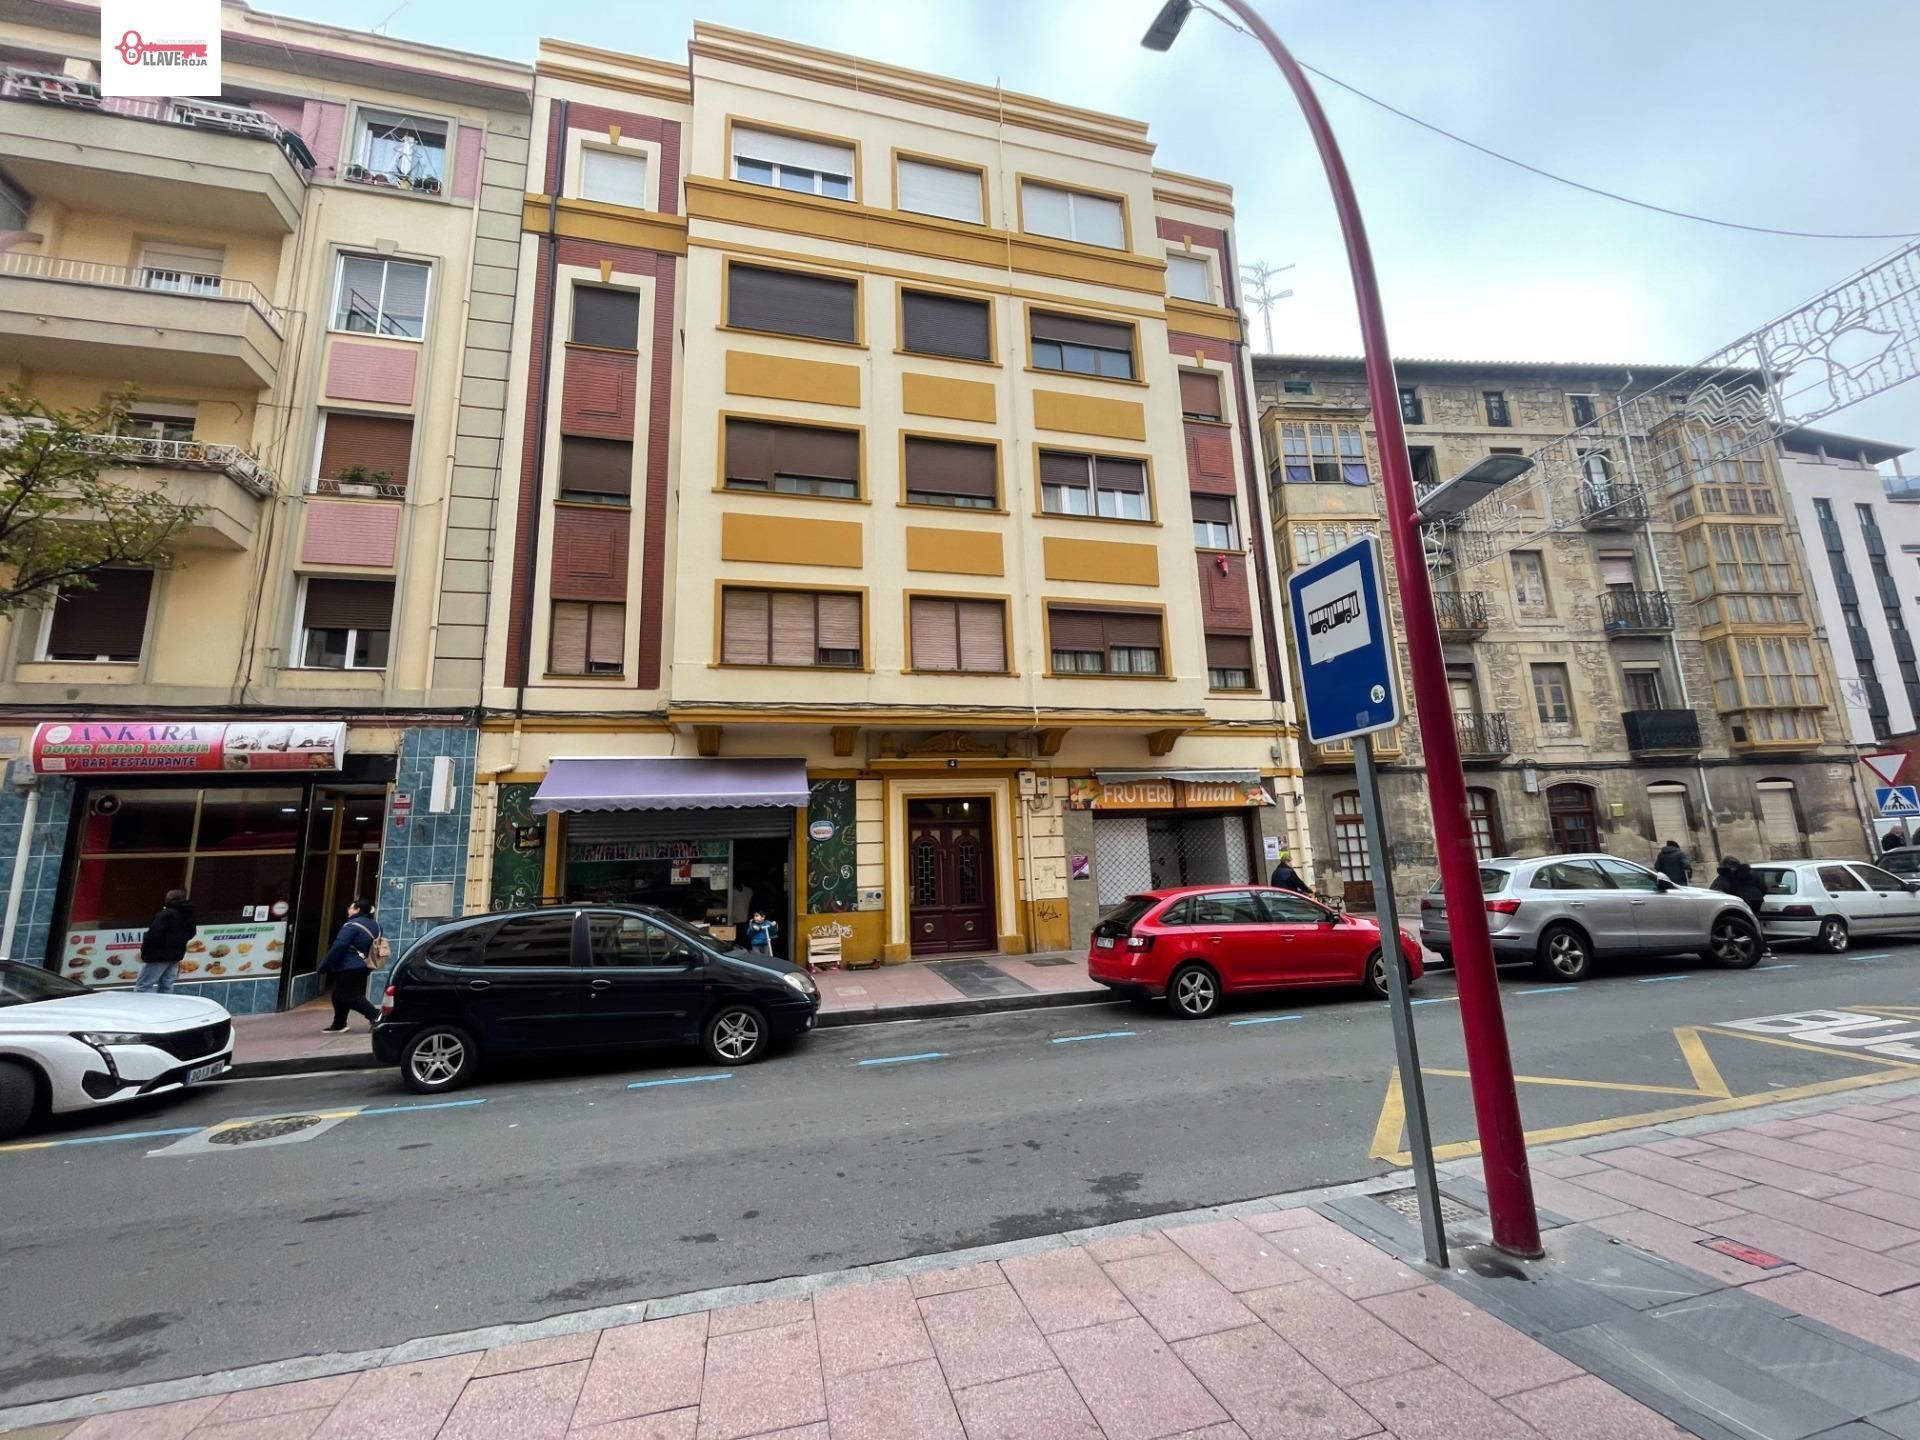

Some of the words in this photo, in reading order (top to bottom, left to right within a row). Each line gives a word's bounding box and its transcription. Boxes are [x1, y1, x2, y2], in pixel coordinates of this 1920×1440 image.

[72, 726, 200, 741] ANKARA
[96, 743, 143, 754] KEBAB
[70, 758, 78, 768] Y
[82, 758, 106, 768] BAR
[111, 757, 196, 767] RESTAURANTE
[212, 932, 258, 941] RESTAURANTE
